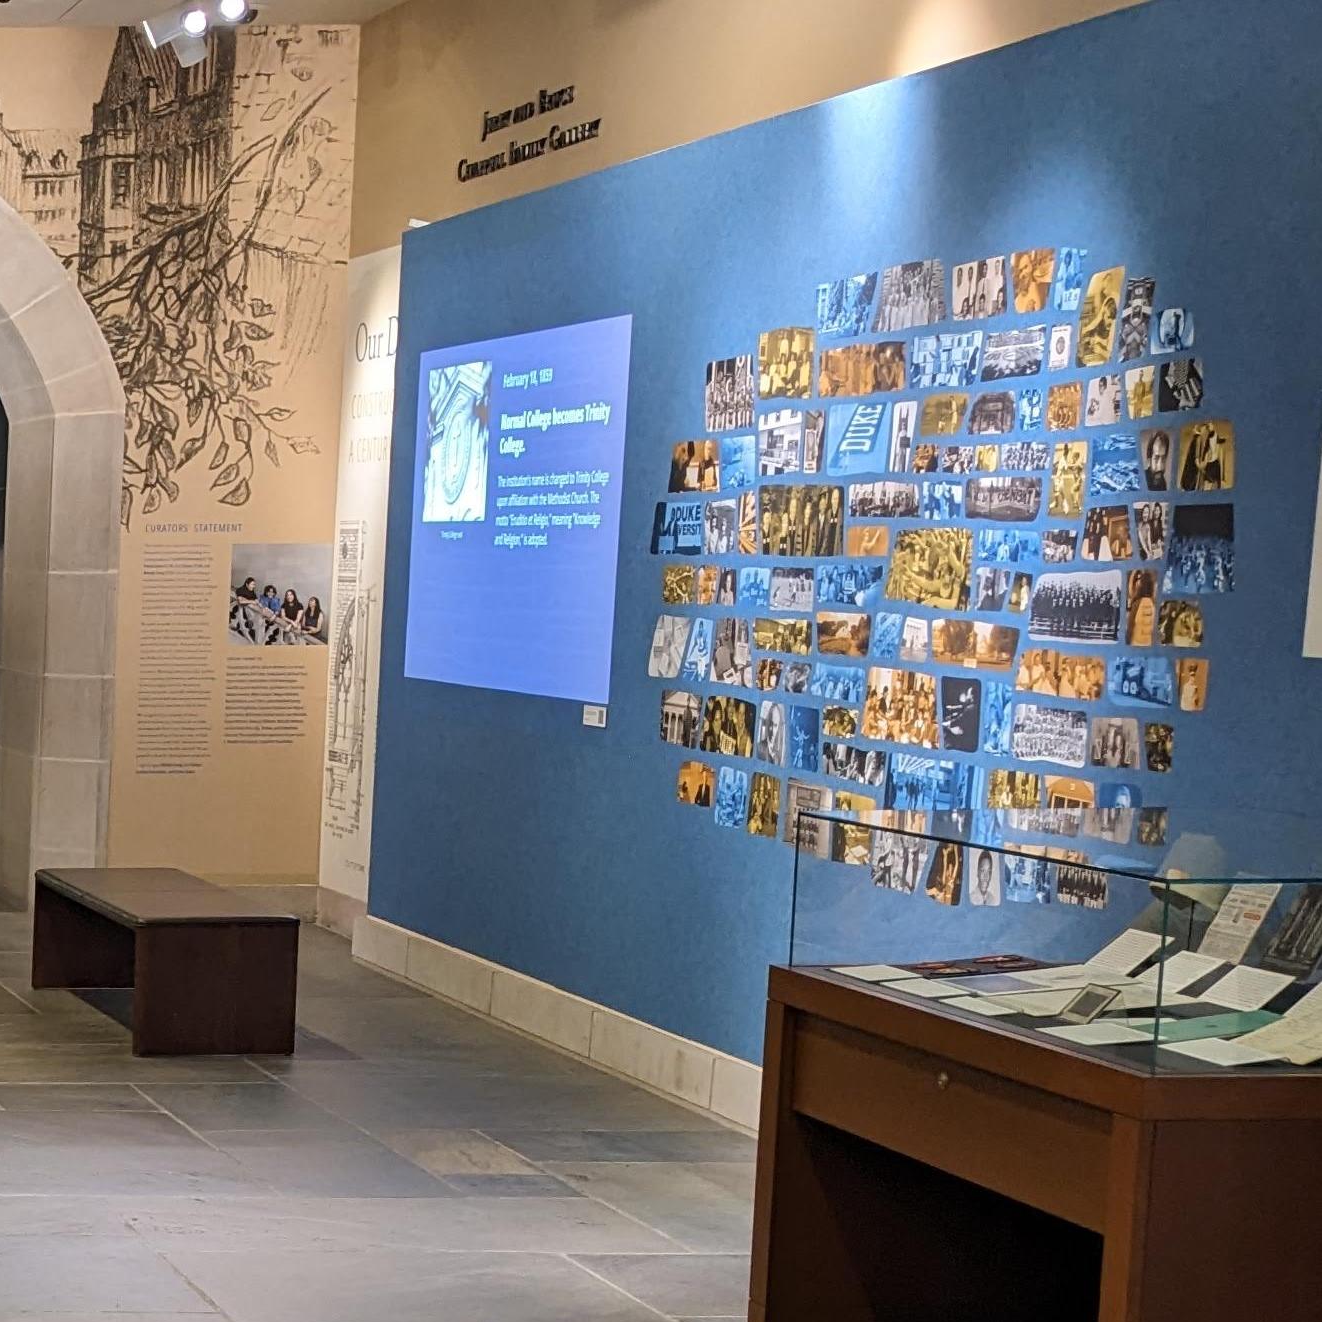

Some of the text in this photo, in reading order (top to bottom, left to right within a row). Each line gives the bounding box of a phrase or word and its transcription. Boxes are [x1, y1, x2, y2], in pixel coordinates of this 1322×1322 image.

[356, 322, 383, 362] Our
[501, 401, 611, 432] Normal College becomes Trinity
[838, 403, 883, 453] DUKE
[499, 436, 526, 459] College.
[675, 505, 701, 521] DUKE
[145, 523, 242, 533] CURATORS STATEMENT
